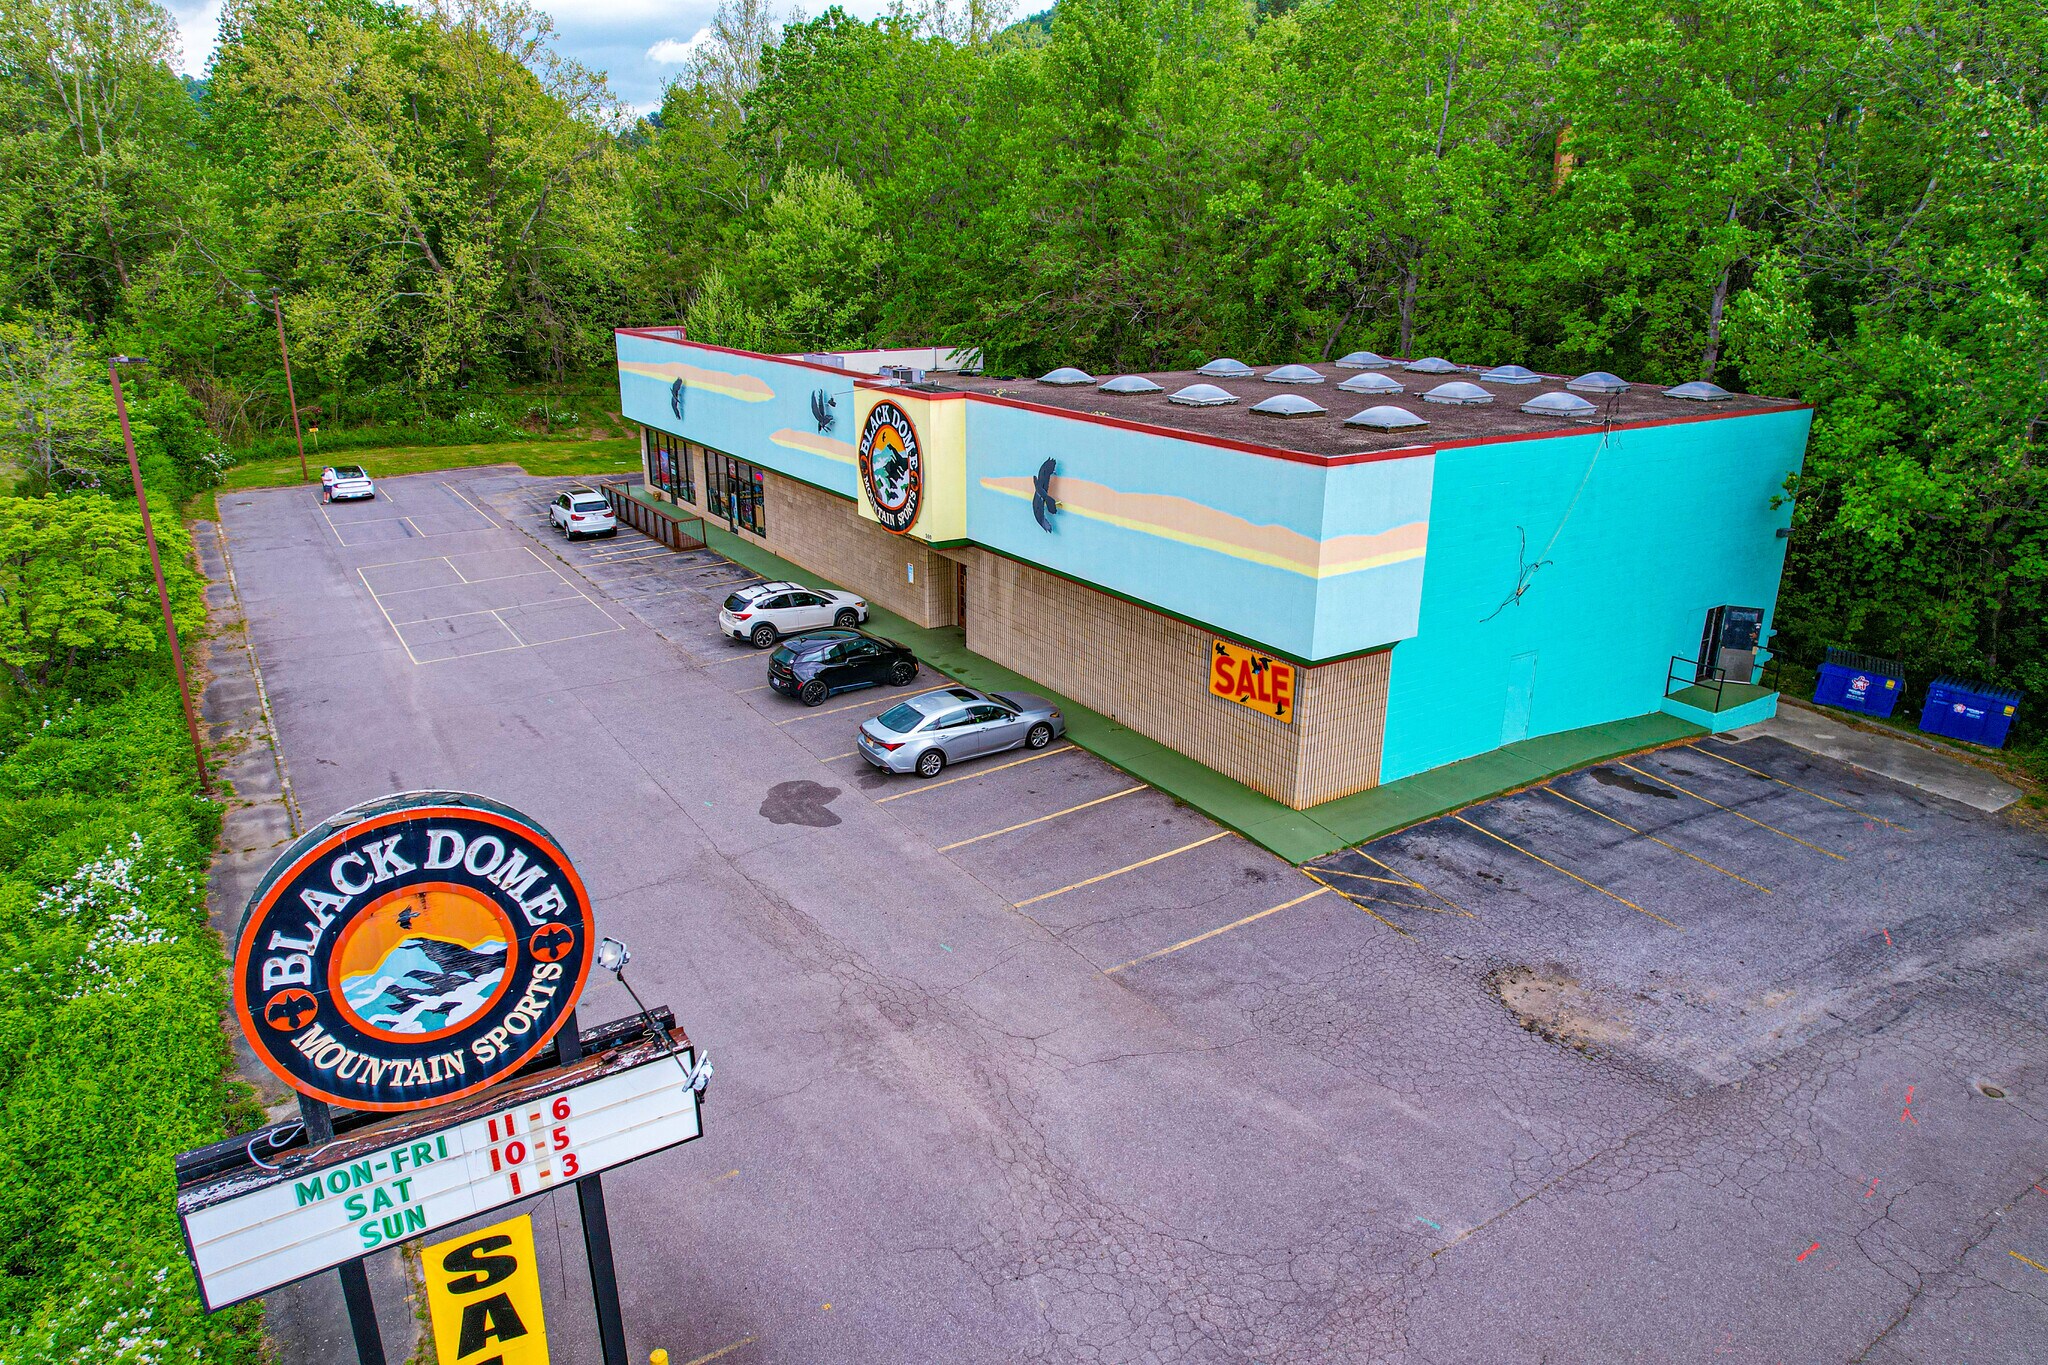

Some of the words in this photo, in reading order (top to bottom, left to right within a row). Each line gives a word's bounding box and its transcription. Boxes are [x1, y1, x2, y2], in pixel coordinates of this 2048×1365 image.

[860, 404, 890, 456] BLACK
[892, 409, 918, 471] DOME
[863, 477, 896, 527] MOUNTAIN
[897, 489, 917, 526] SPORTS
[1214, 655, 1291, 708] SALE
[262, 836, 416, 991] BLACK
[422, 828, 568, 927] DOME
[293, 1022, 469, 1088] MOUNTAIN
[474, 962, 564, 1066] SPORTS
[294, 1135, 448, 1207] MON-FRI
[344, 1176, 412, 1222] SAT
[359, 1204, 427, 1249] SUN
[440, 1234, 529, 1365] SA
